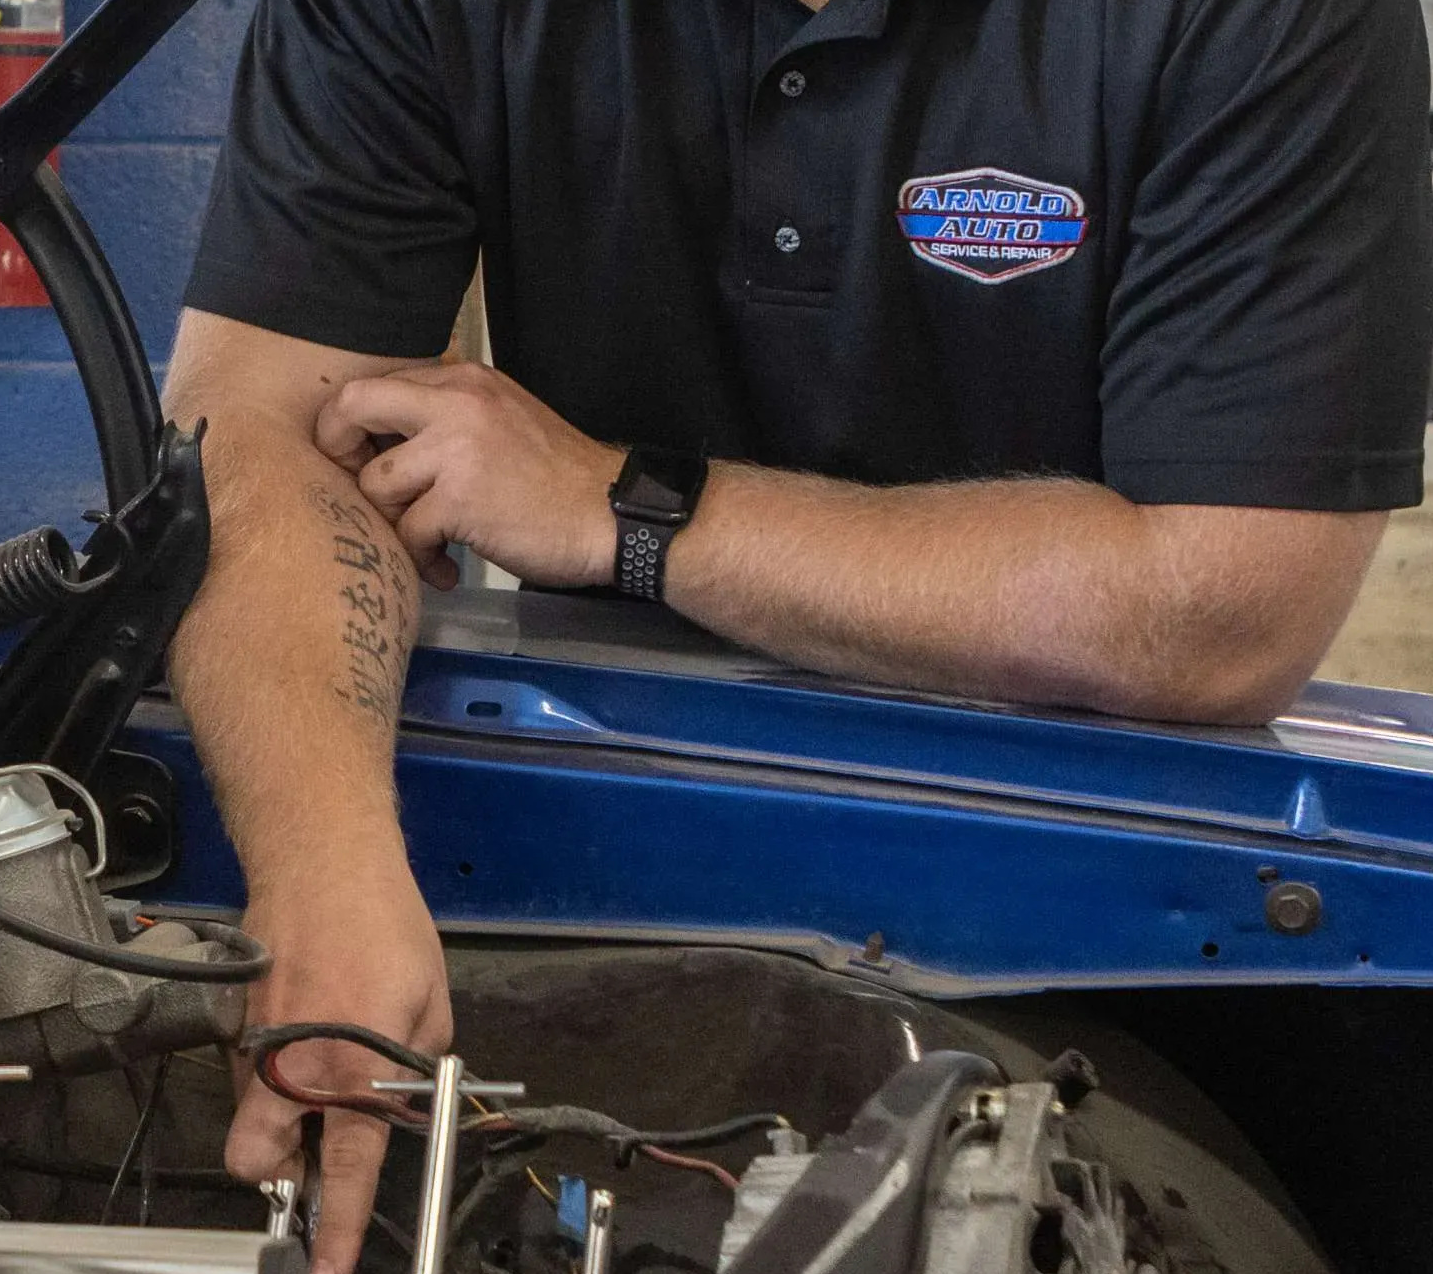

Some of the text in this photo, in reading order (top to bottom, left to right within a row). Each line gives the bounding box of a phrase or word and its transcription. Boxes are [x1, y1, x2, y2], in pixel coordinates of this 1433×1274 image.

[912, 188, 1065, 215] ARNOLD
[935, 217, 1041, 242] AUTO
[930, 243, 1051, 259] SERVICE & REPAIR
